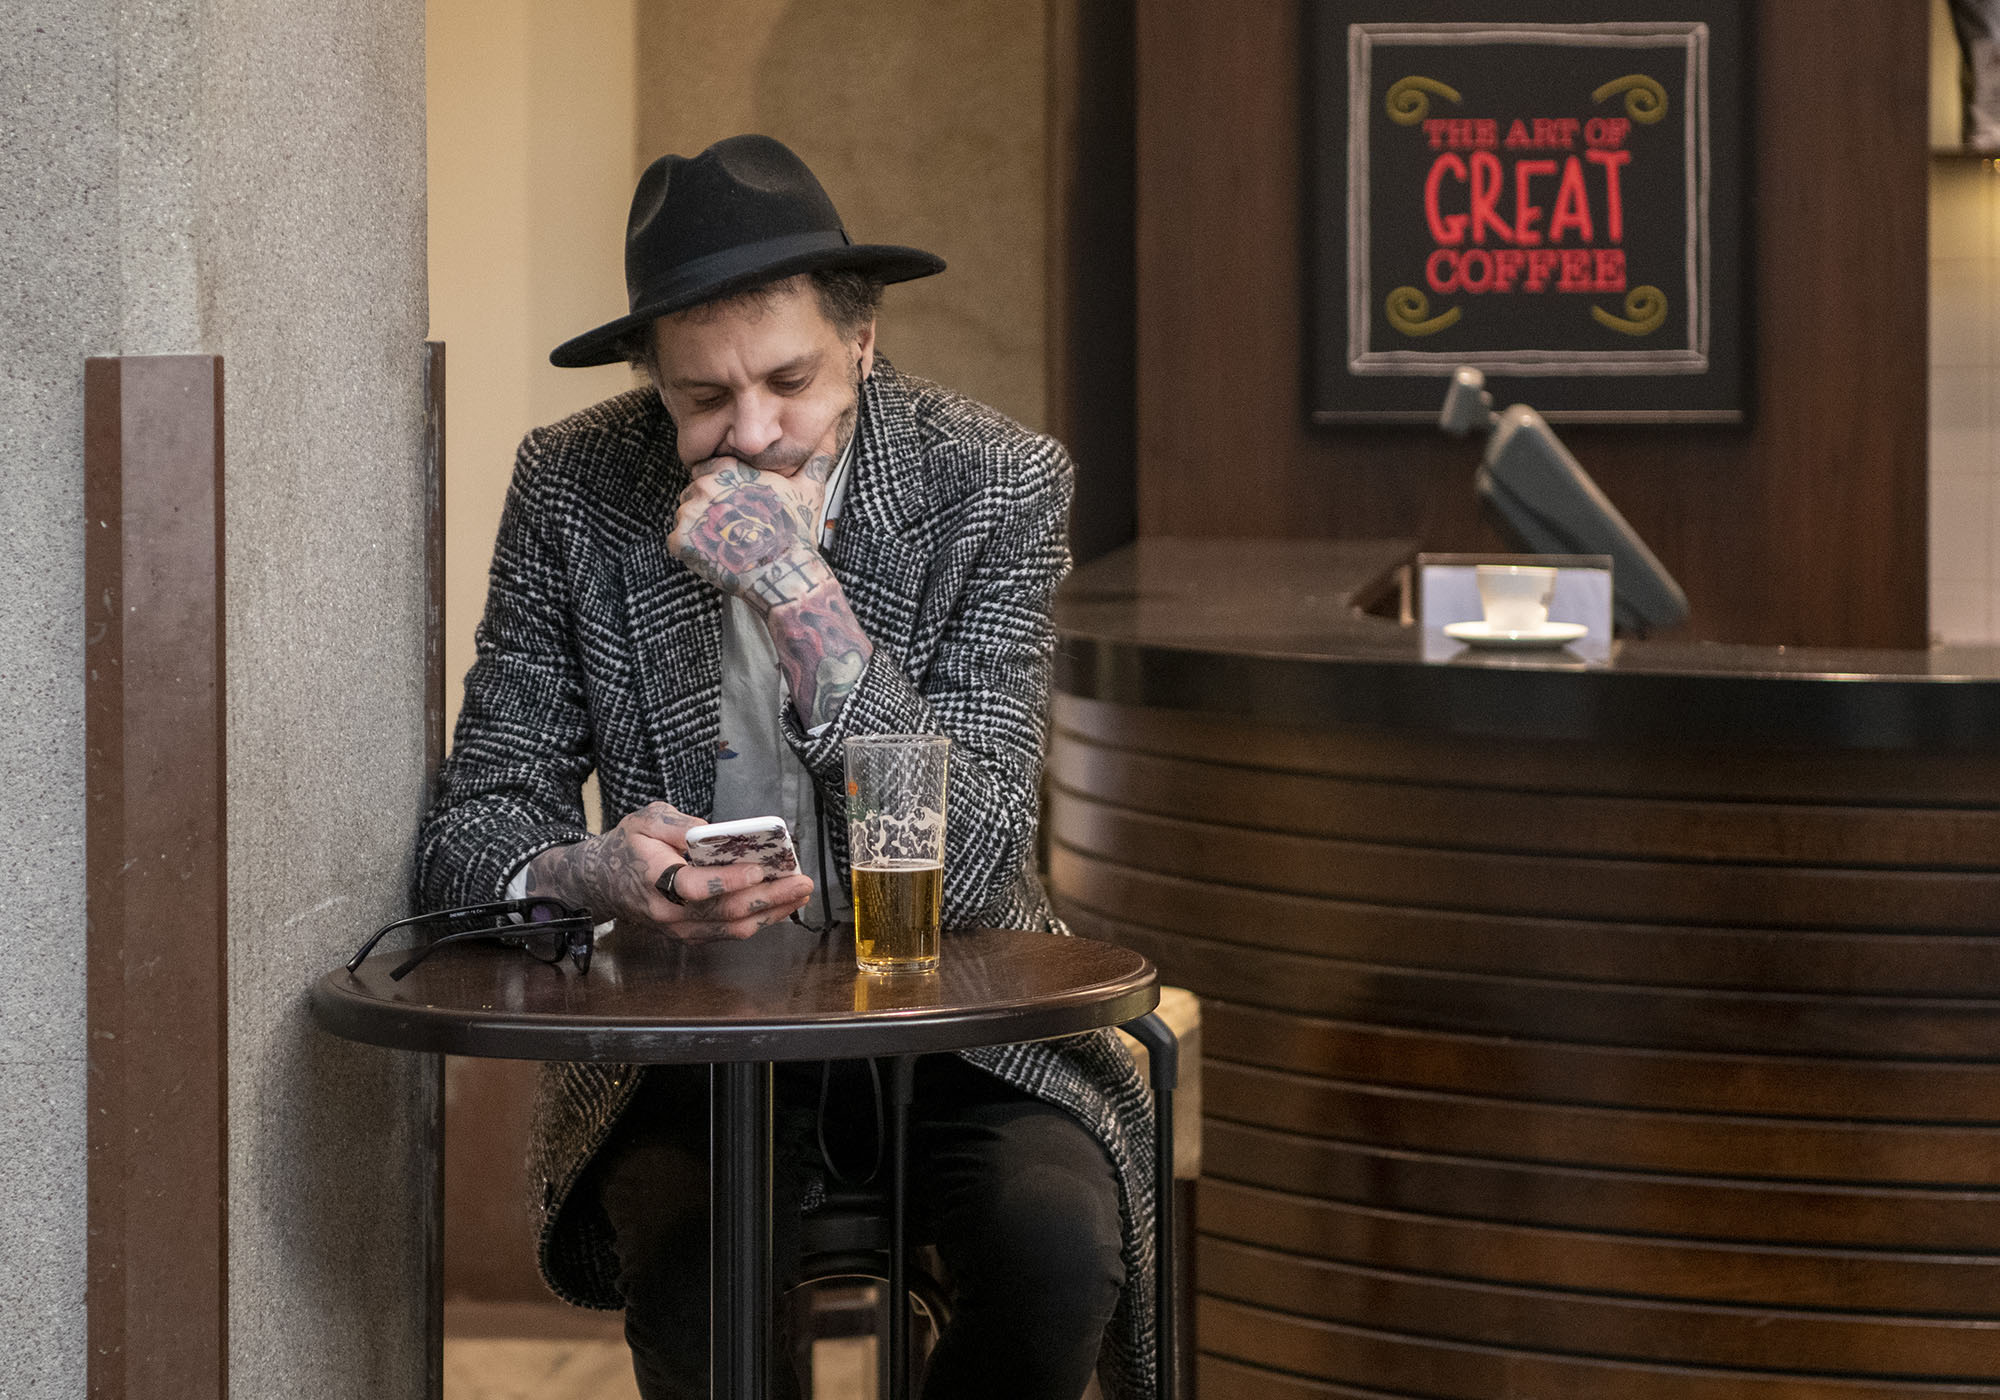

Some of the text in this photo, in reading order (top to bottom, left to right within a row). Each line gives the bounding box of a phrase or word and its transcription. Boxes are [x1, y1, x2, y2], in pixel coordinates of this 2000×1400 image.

[1423, 117, 1631, 149] THE ART OF
[1424, 150, 1631, 246] GREAT
[1426, 249, 1627, 293] COFFEE
